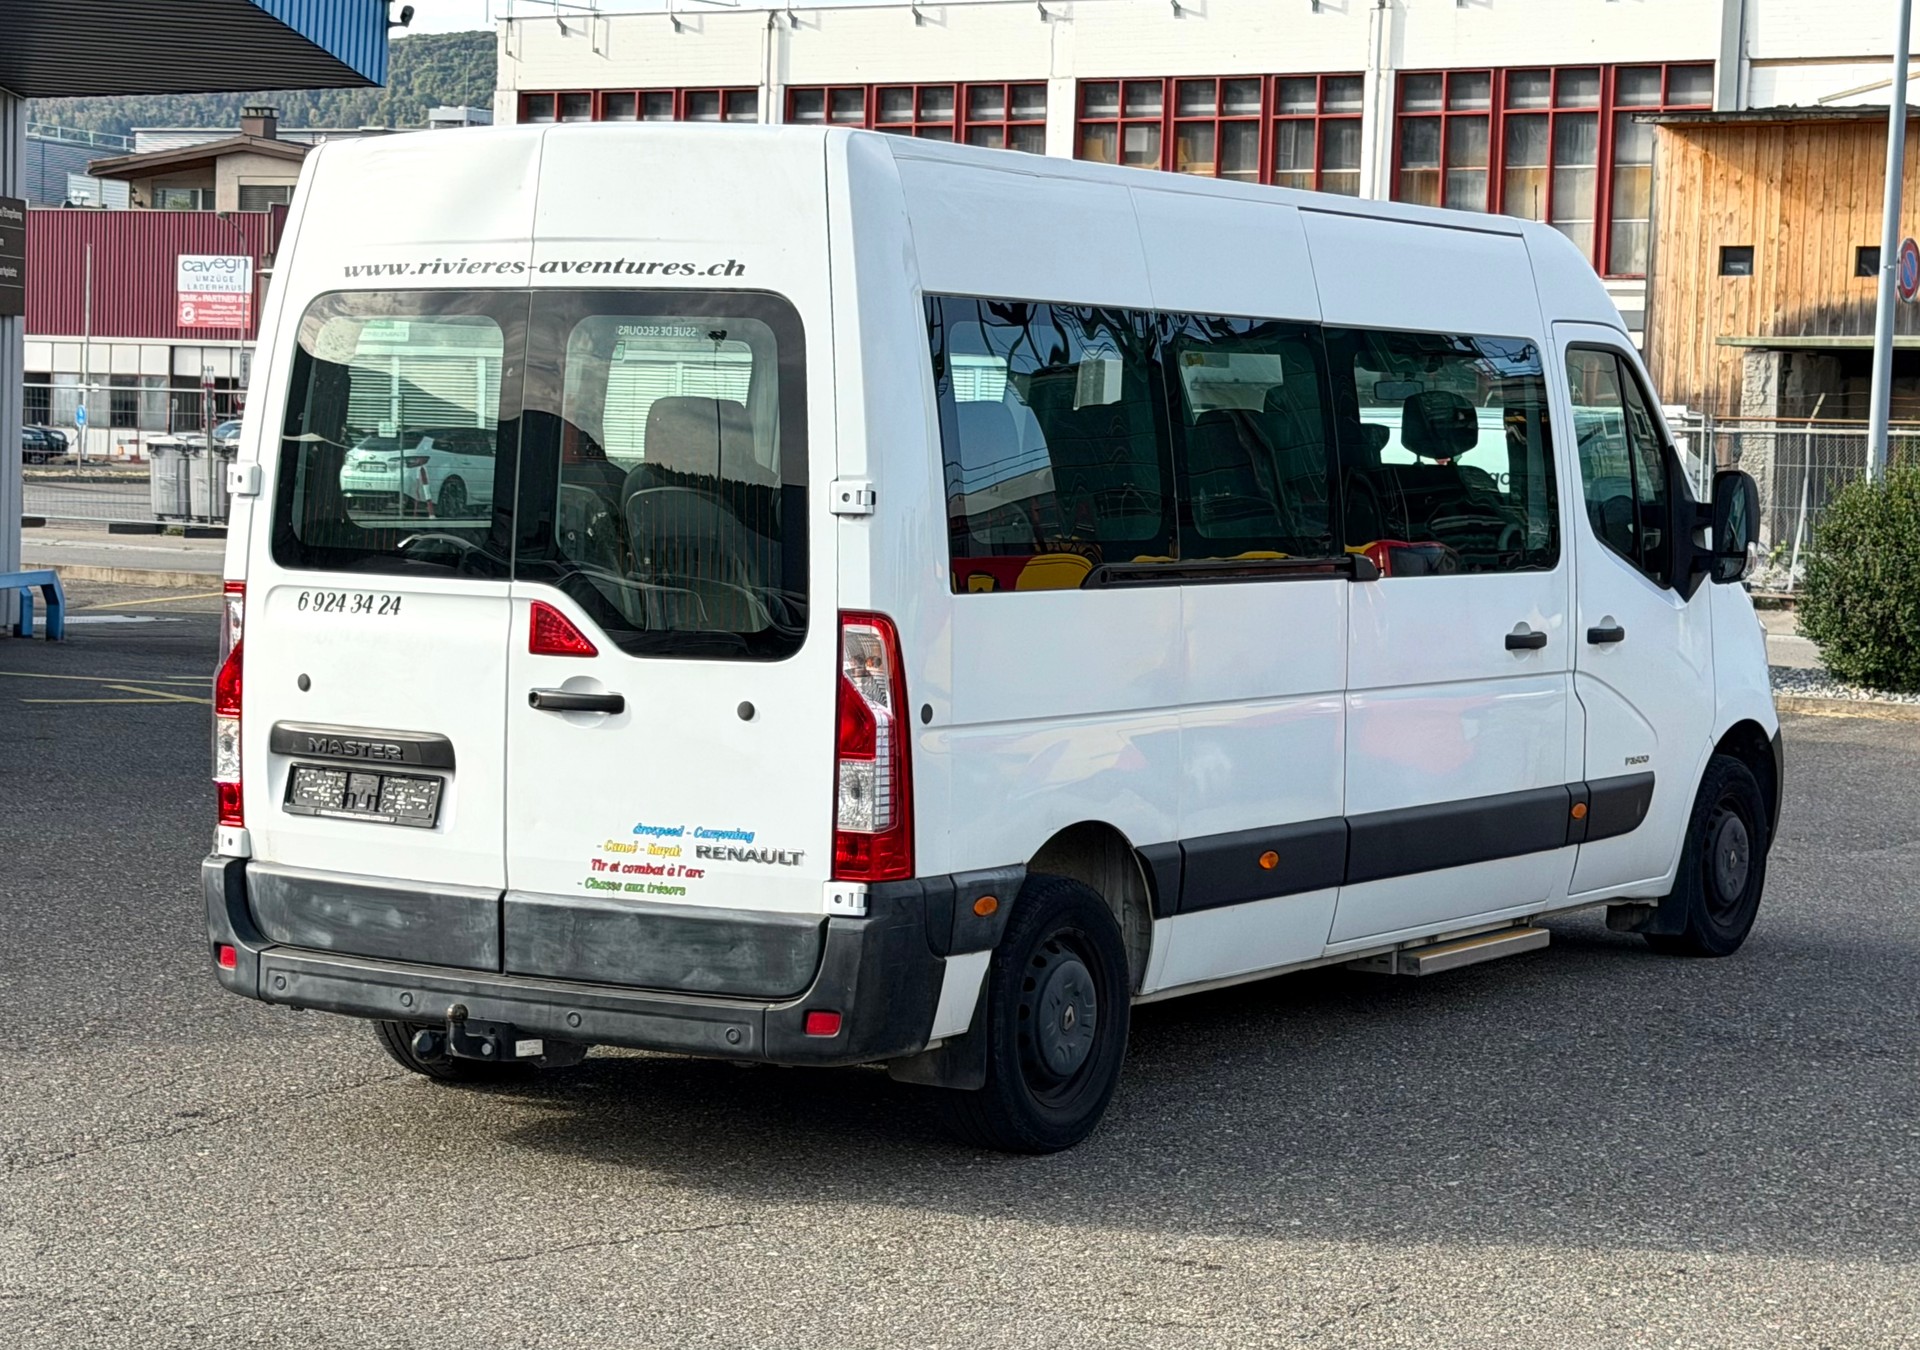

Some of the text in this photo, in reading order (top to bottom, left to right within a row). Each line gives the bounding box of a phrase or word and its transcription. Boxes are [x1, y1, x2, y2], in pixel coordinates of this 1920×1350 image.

[182, 258, 249, 273] cavegn
[344, 257, 746, 278] www.rivieres-aventures.ch
[298, 591, 402, 616] 6 924 34 24
[308, 737, 403, 760] MASTER
[696, 845, 804, 866] RENAULT
[592, 859, 608, 872] Tir
[610, 861, 621, 873] et
[622, 863, 666, 876] combat
[585, 877, 622, 891] Chasse
[624, 883, 645, 894] aux
